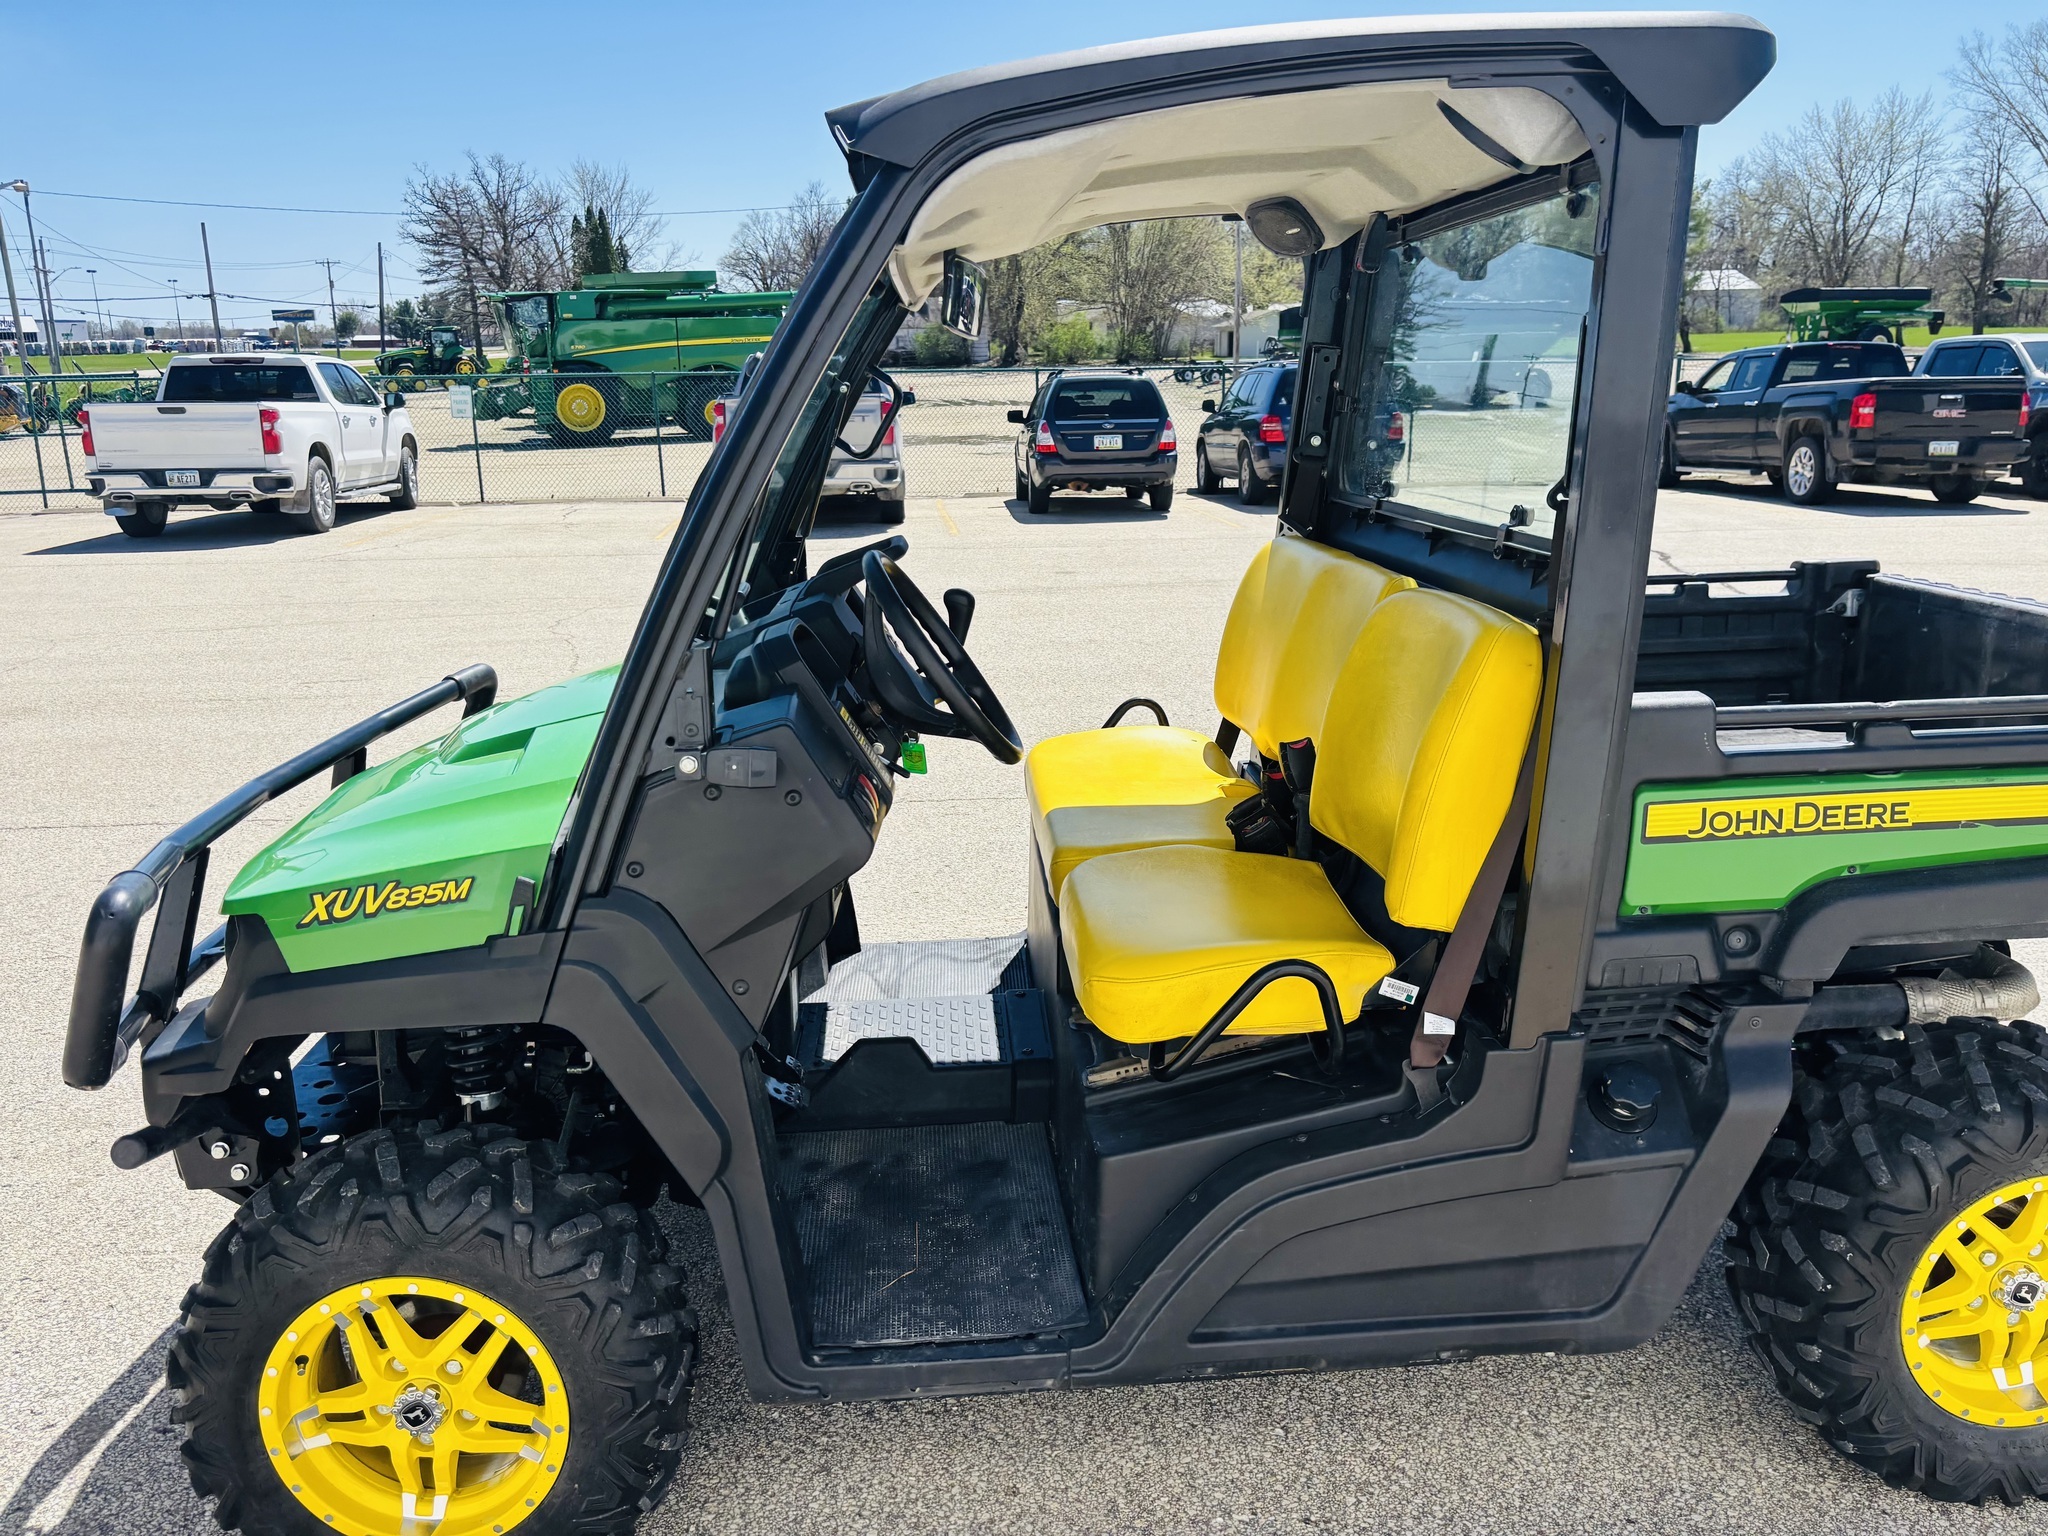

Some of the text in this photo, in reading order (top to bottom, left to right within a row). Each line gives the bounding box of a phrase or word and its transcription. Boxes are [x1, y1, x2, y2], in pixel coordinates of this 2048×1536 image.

[1933, 409, 1966, 418] GMC
[1687, 801, 1911, 835] JOHN DEERE
[298, 877, 474, 927] XUV835M
